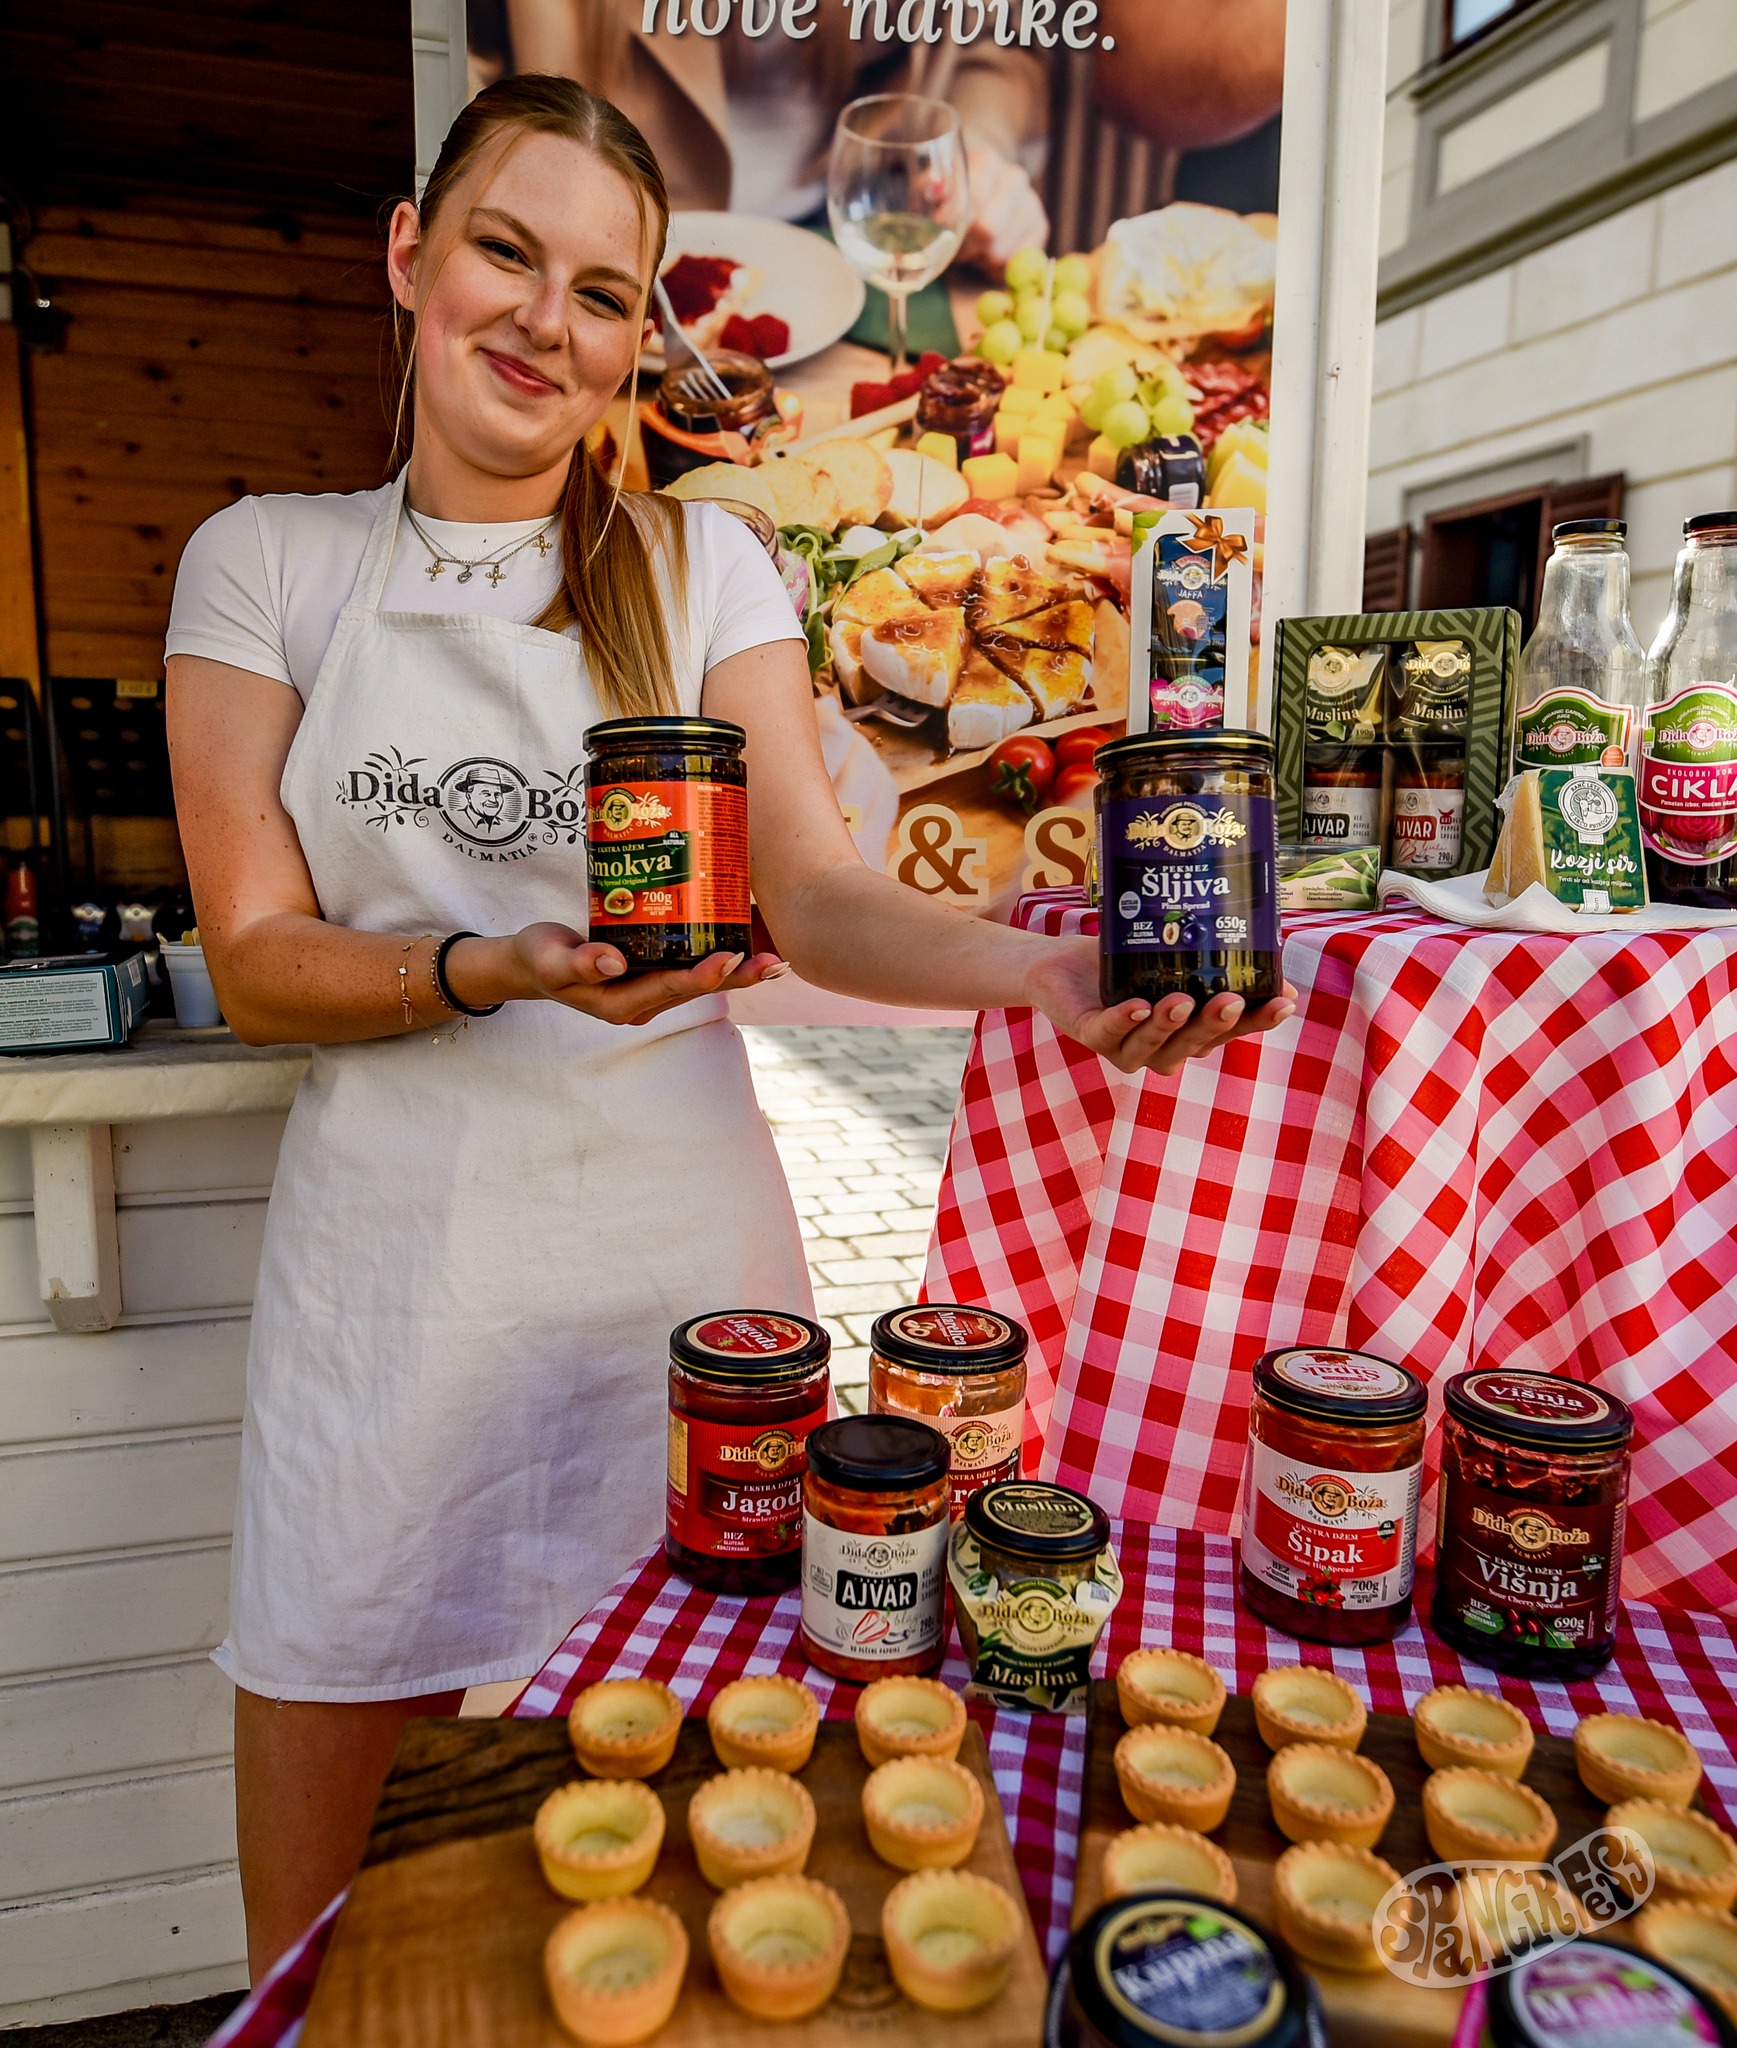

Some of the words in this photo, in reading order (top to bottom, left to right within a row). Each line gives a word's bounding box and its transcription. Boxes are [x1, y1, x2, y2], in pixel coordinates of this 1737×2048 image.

[641, 0, 818, 39] nove
[841, 0, 1116, 51] navike.
[1178, 588, 1203, 599] JAFFA
[1306, 705, 1360, 721] Maslina
[1565, 709, 1587, 721] CARROT
[1527, 732, 1549, 744] Dida
[1575, 728, 1605, 743] Boža
[1660, 730, 1688, 742] Dida
[1667, 768, 1711, 778] EKOLOŠKI
[1716, 767, 1733, 777] SOK
[348, 771, 444, 808] Dida
[526, 788, 586, 823] Bo
[1660, 799, 1685, 807] Pametan
[1203, 817, 1241, 835] Boža
[1303, 818, 1346, 835] AJVAR
[1396, 820, 1432, 838] AJVAR
[441, 832, 539, 862] DALMATIA
[597, 845, 622, 853] EKSTRA
[622, 843, 645, 852] DŽEM
[898, 815, 979, 895] &
[1163, 844, 1207, 857] DALMATIA
[588, 853, 673, 877] Smokva
[1162, 864, 1209, 872] PEKMEZ
[1550, 849, 1606, 876] Kozji
[1606, 854, 1637, 874] sir
[622, 876, 648, 886] Original
[1141, 867, 1231, 903] Šljiva
[1590, 878, 1610, 887] kozjeg
[642, 891, 673, 905] 700g
[1161, 902, 1181, 910] Plum
[1182, 901, 1210, 911] Spread
[1133, 921, 1153, 930] BEZ
[1215, 916, 1247, 932] 650g
[728, 1318, 778, 1350] Jagoda
[937, 1312, 967, 1346] Marelica
[1488, 1385, 1585, 1408] Višnja
[986, 1430, 1011, 1447] Boža
[721, 1447, 757, 1462] Dida
[949, 1473, 975, 1481] KSTRA
[976, 1469, 997, 1480] DŽEM
[744, 1484, 776, 1492] EKSTRA
[778, 1477, 799, 1490] DŽEM
[1277, 1476, 1313, 1500] Dida
[1348, 1494, 1384, 1509] Boža
[722, 1483, 801, 1517] Jagod
[991, 1501, 1080, 1513] Maslina
[742, 1514, 778, 1523] Strawberry
[1307, 1510, 1349, 1525] DALMATIA
[1296, 1522, 1331, 1540] EKSTRA
[1332, 1529, 1359, 1541] DŽEM
[1473, 1508, 1512, 1534] Dida
[1550, 1527, 1589, 1544] Boža
[723, 1532, 744, 1540] BEZ
[841, 1544, 867, 1559] Dida
[1288, 1527, 1364, 1564] Šipak
[1507, 1543, 1552, 1560] DALMATIA
[1272, 1560, 1290, 1575] BEZ
[1293, 1554, 1311, 1567] Rose
[1312, 1561, 1327, 1571] Hip
[1328, 1564, 1355, 1574] Spread
[1494, 1556, 1533, 1573] EKSTRA
[1534, 1565, 1563, 1577] DŽEM
[1351, 1581, 1379, 1592] 700g
[1476, 1554, 1578, 1603] Višnja
[842, 1580, 912, 1608] AJVAR
[1488, 1588, 1507, 1600] Sour
[1507, 1595, 1535, 1608] Cherry
[1536, 1601, 1564, 1610] Spread
[1470, 1598, 1491, 1612] BEZ
[983, 1604, 1019, 1619] Dida
[1053, 1609, 1090, 1624] Boža
[1554, 1617, 1585, 1632] 690g
[987, 1663, 1079, 1686] Maslina
